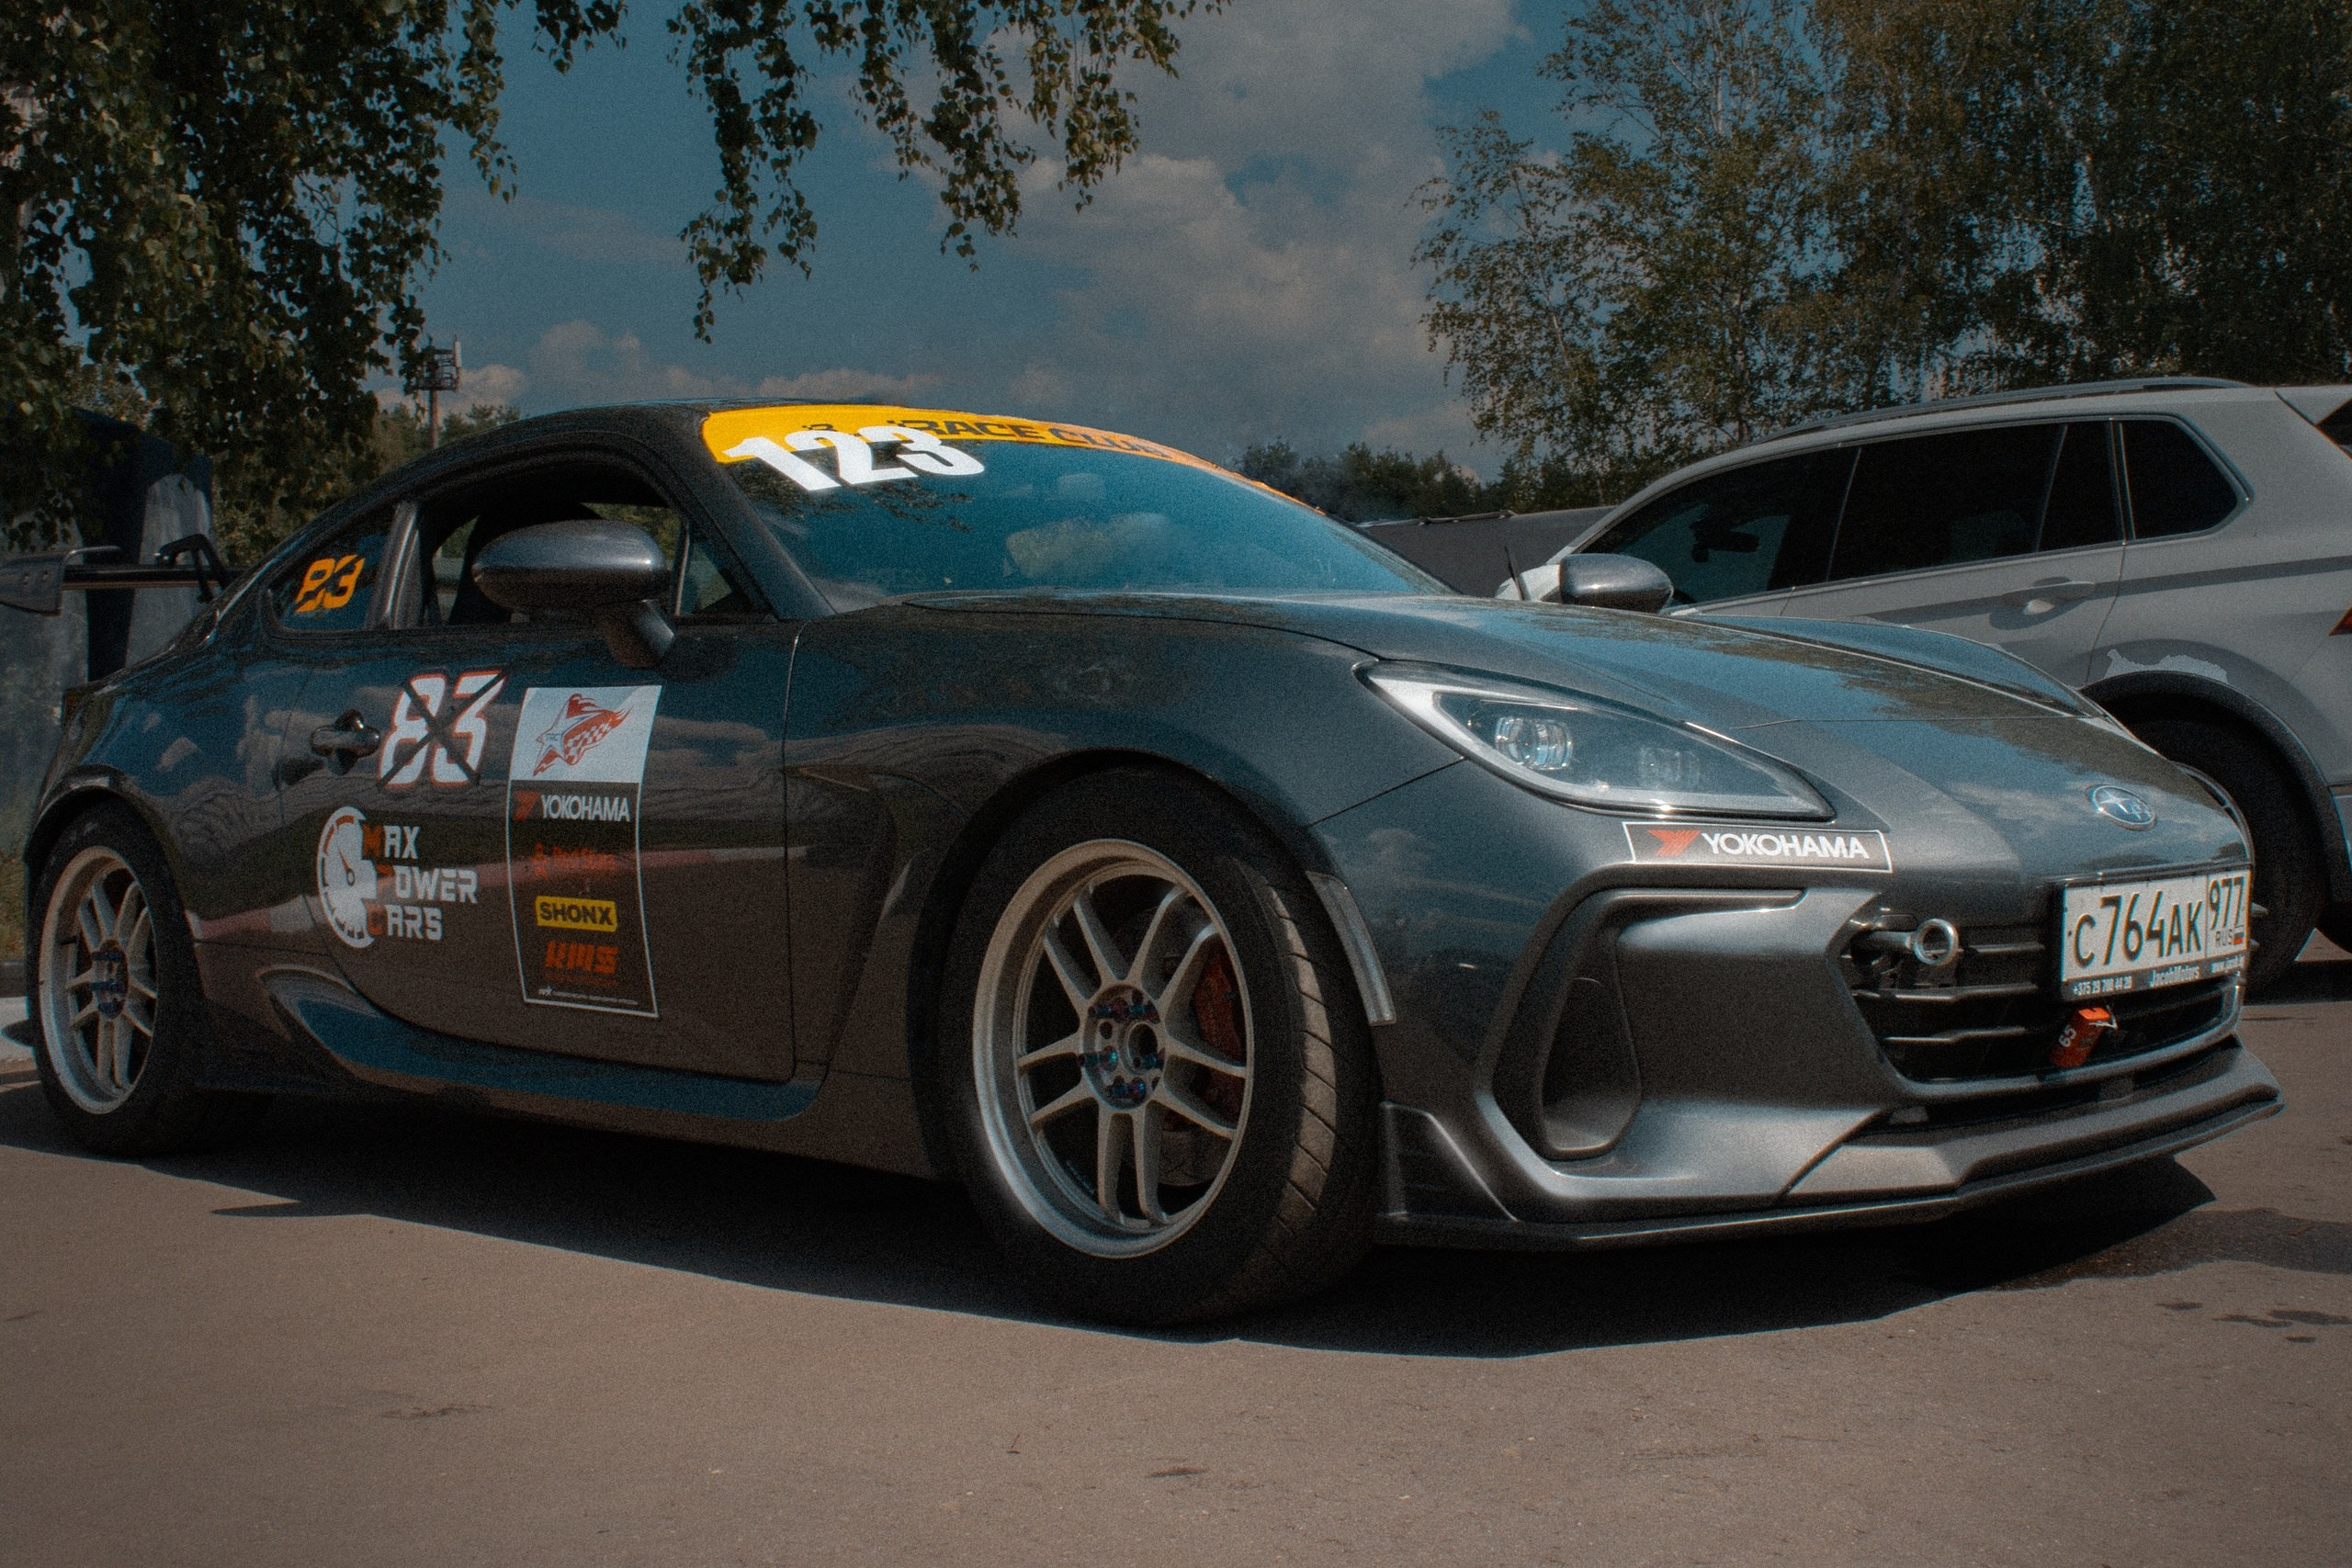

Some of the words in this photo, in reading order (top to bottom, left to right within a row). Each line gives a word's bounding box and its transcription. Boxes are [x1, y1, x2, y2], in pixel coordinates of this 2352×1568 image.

[887, 420, 1046, 441] RACE
[722, 425, 985, 491] 123
[295, 554, 365, 613] 83
[540, 794, 631, 823] YOKOHAMA
[362, 823, 420, 859] MAX
[1702, 832, 1870, 860] YOKOHAMA
[375, 863, 479, 904] POWER
[539, 901, 614, 926] SHONX
[2209, 875, 2245, 931] 977
[368, 903, 444, 941] CARS
[2215, 929, 2233, 947] RUS
